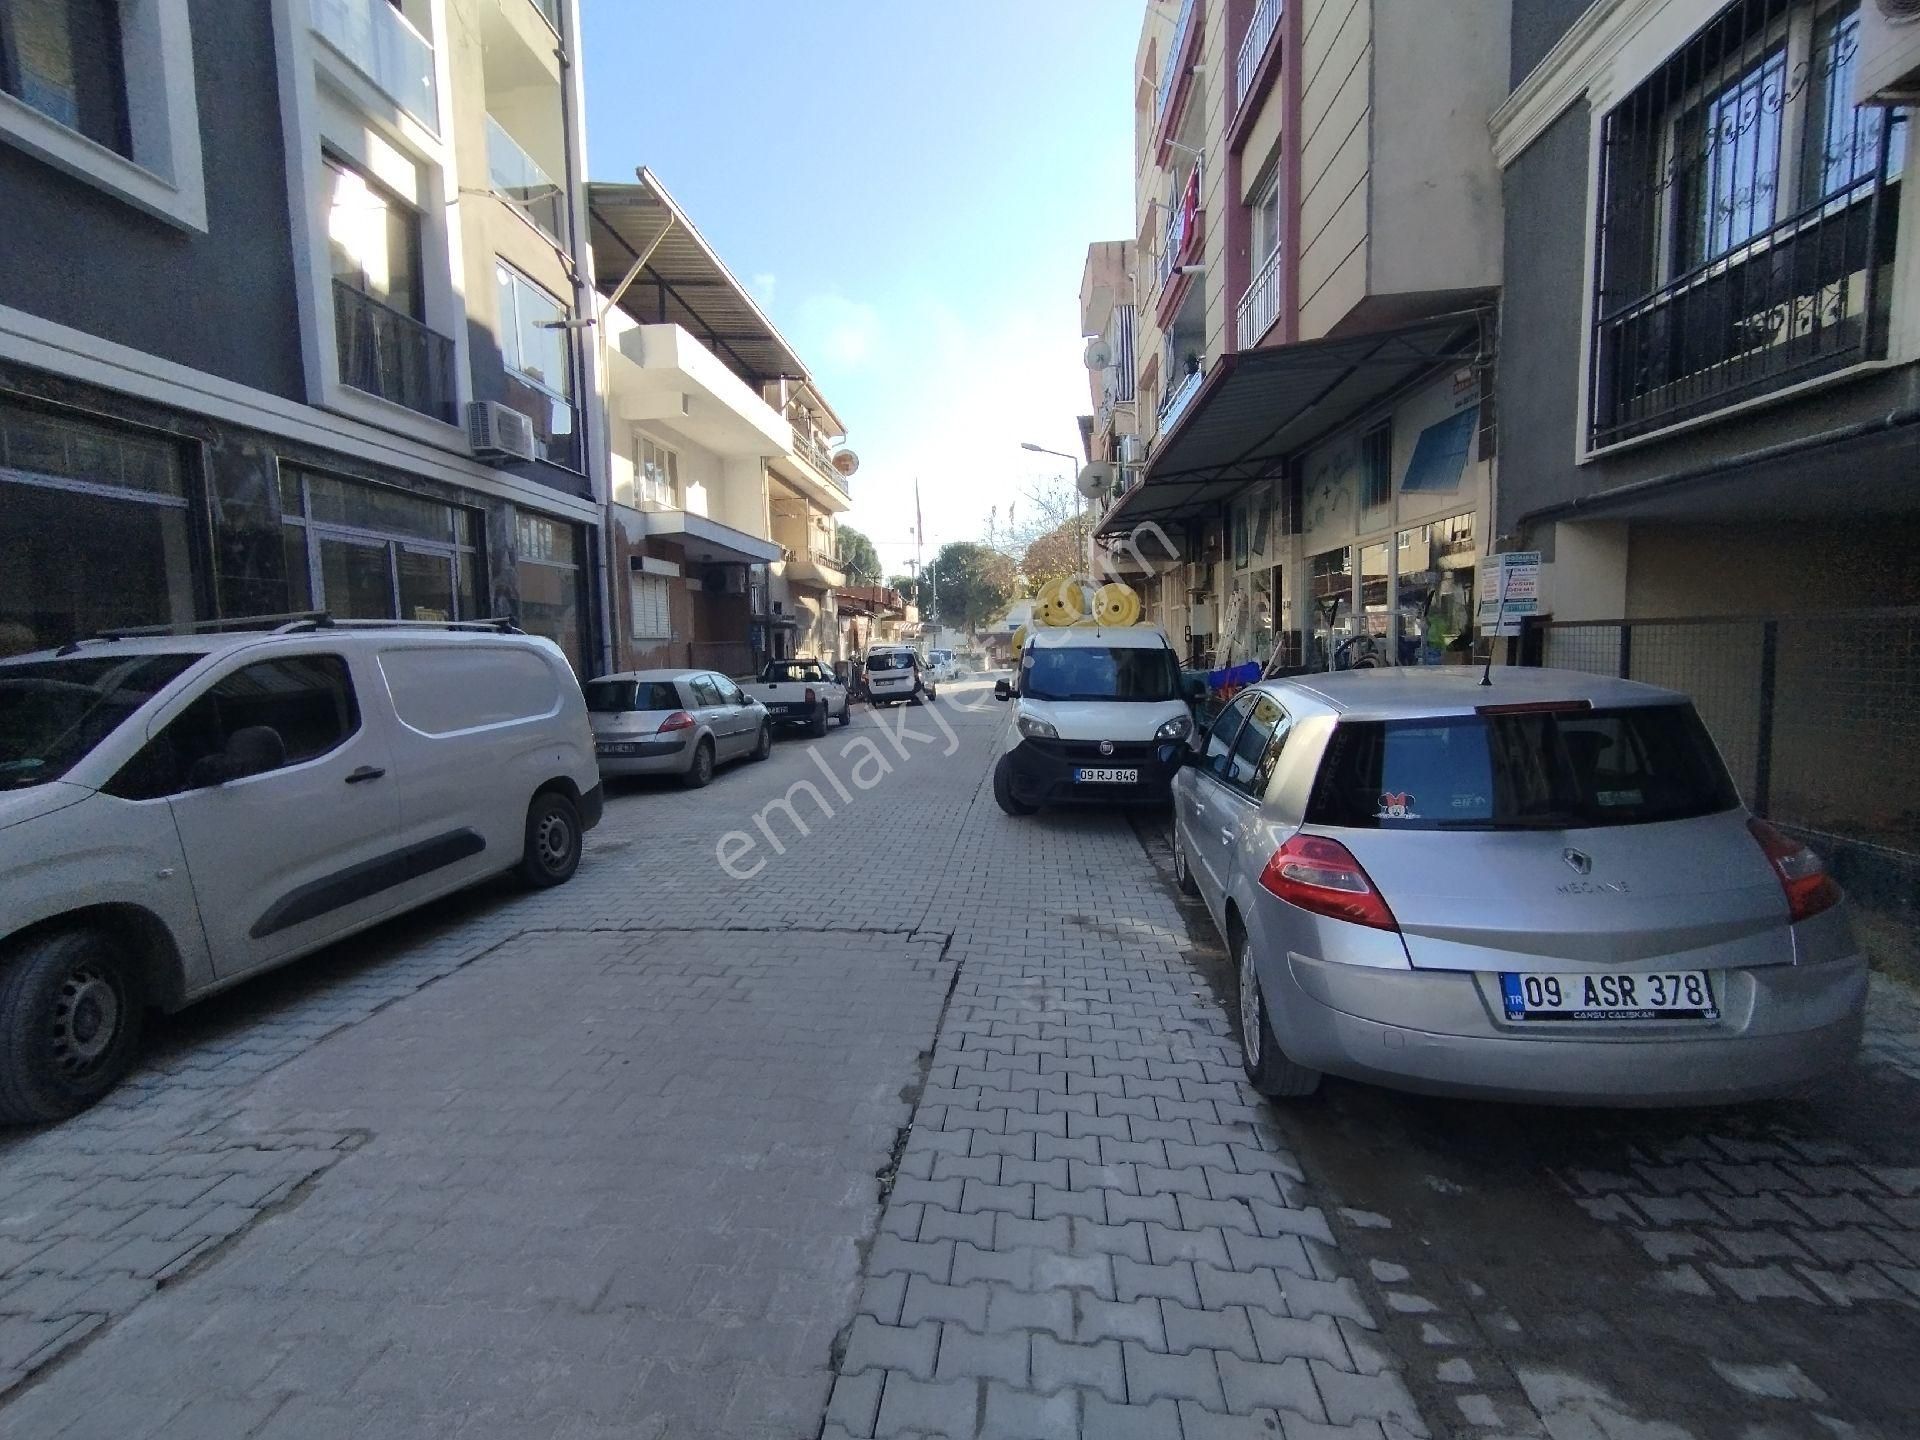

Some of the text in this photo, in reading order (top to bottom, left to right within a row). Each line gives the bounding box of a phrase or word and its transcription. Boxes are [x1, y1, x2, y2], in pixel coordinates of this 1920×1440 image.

[1080, 770, 1136, 781] 09 RJ 846
[1509, 974, 1705, 1007] TR 09 ASR 378
[1573, 1011, 1606, 1019] CANSU
